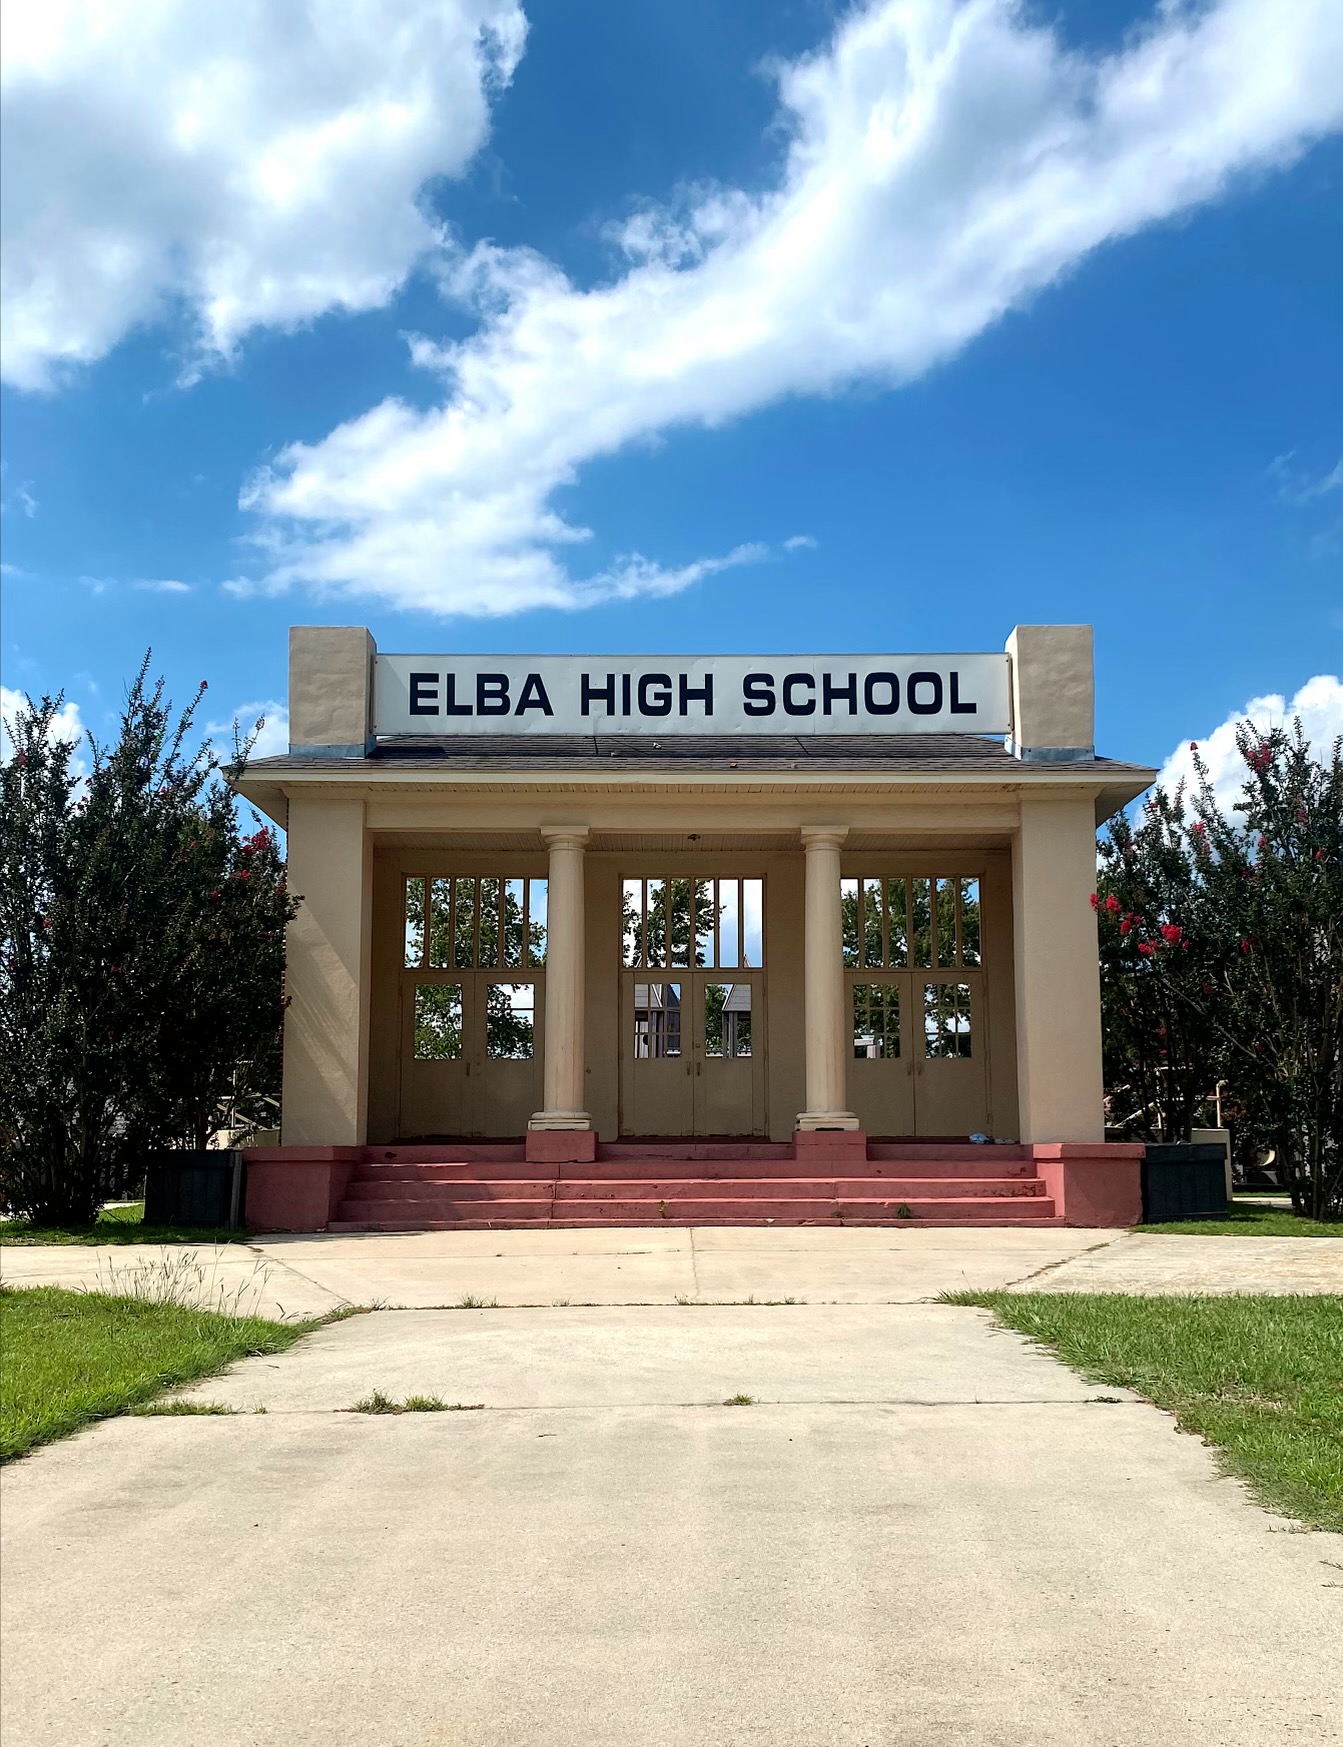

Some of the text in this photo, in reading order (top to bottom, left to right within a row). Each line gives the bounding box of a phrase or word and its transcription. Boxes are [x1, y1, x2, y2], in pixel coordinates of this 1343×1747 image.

[409, 671, 977, 717] ELBA HIGH SCHOOL
